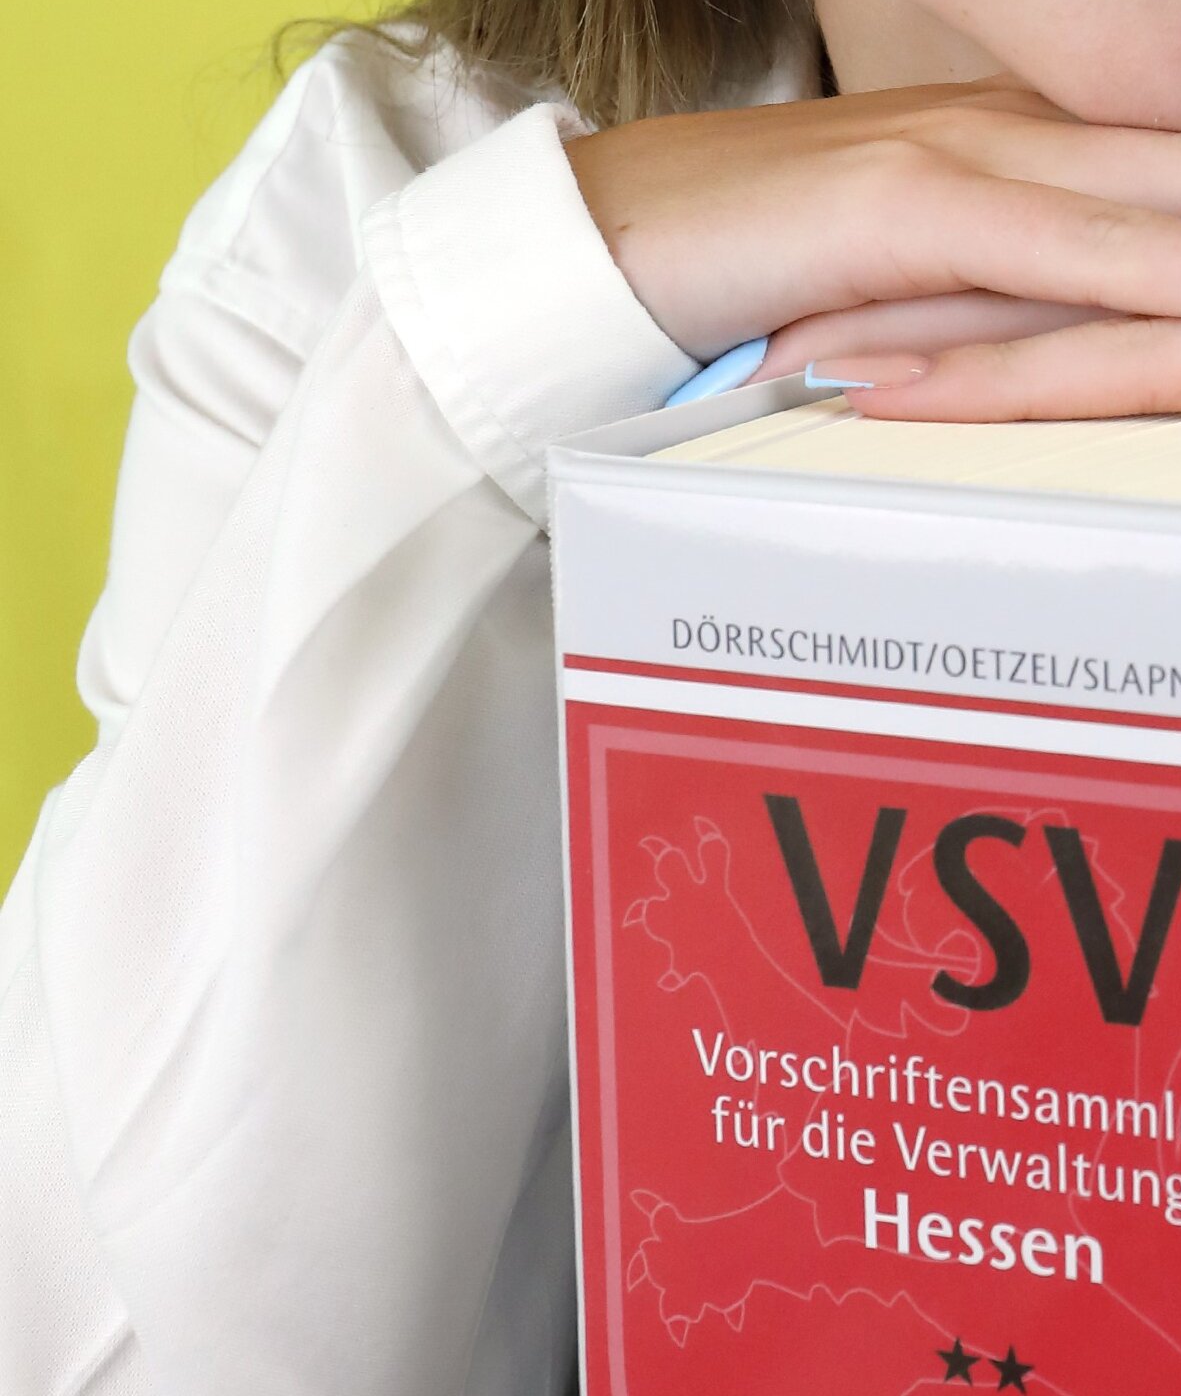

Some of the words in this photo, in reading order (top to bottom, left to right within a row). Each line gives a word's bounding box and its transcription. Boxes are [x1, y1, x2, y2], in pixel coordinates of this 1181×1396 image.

[711, 1095, 786, 1152] für
[801, 1109, 877, 1166] die
[862, 1187, 1104, 1285] Hessen
